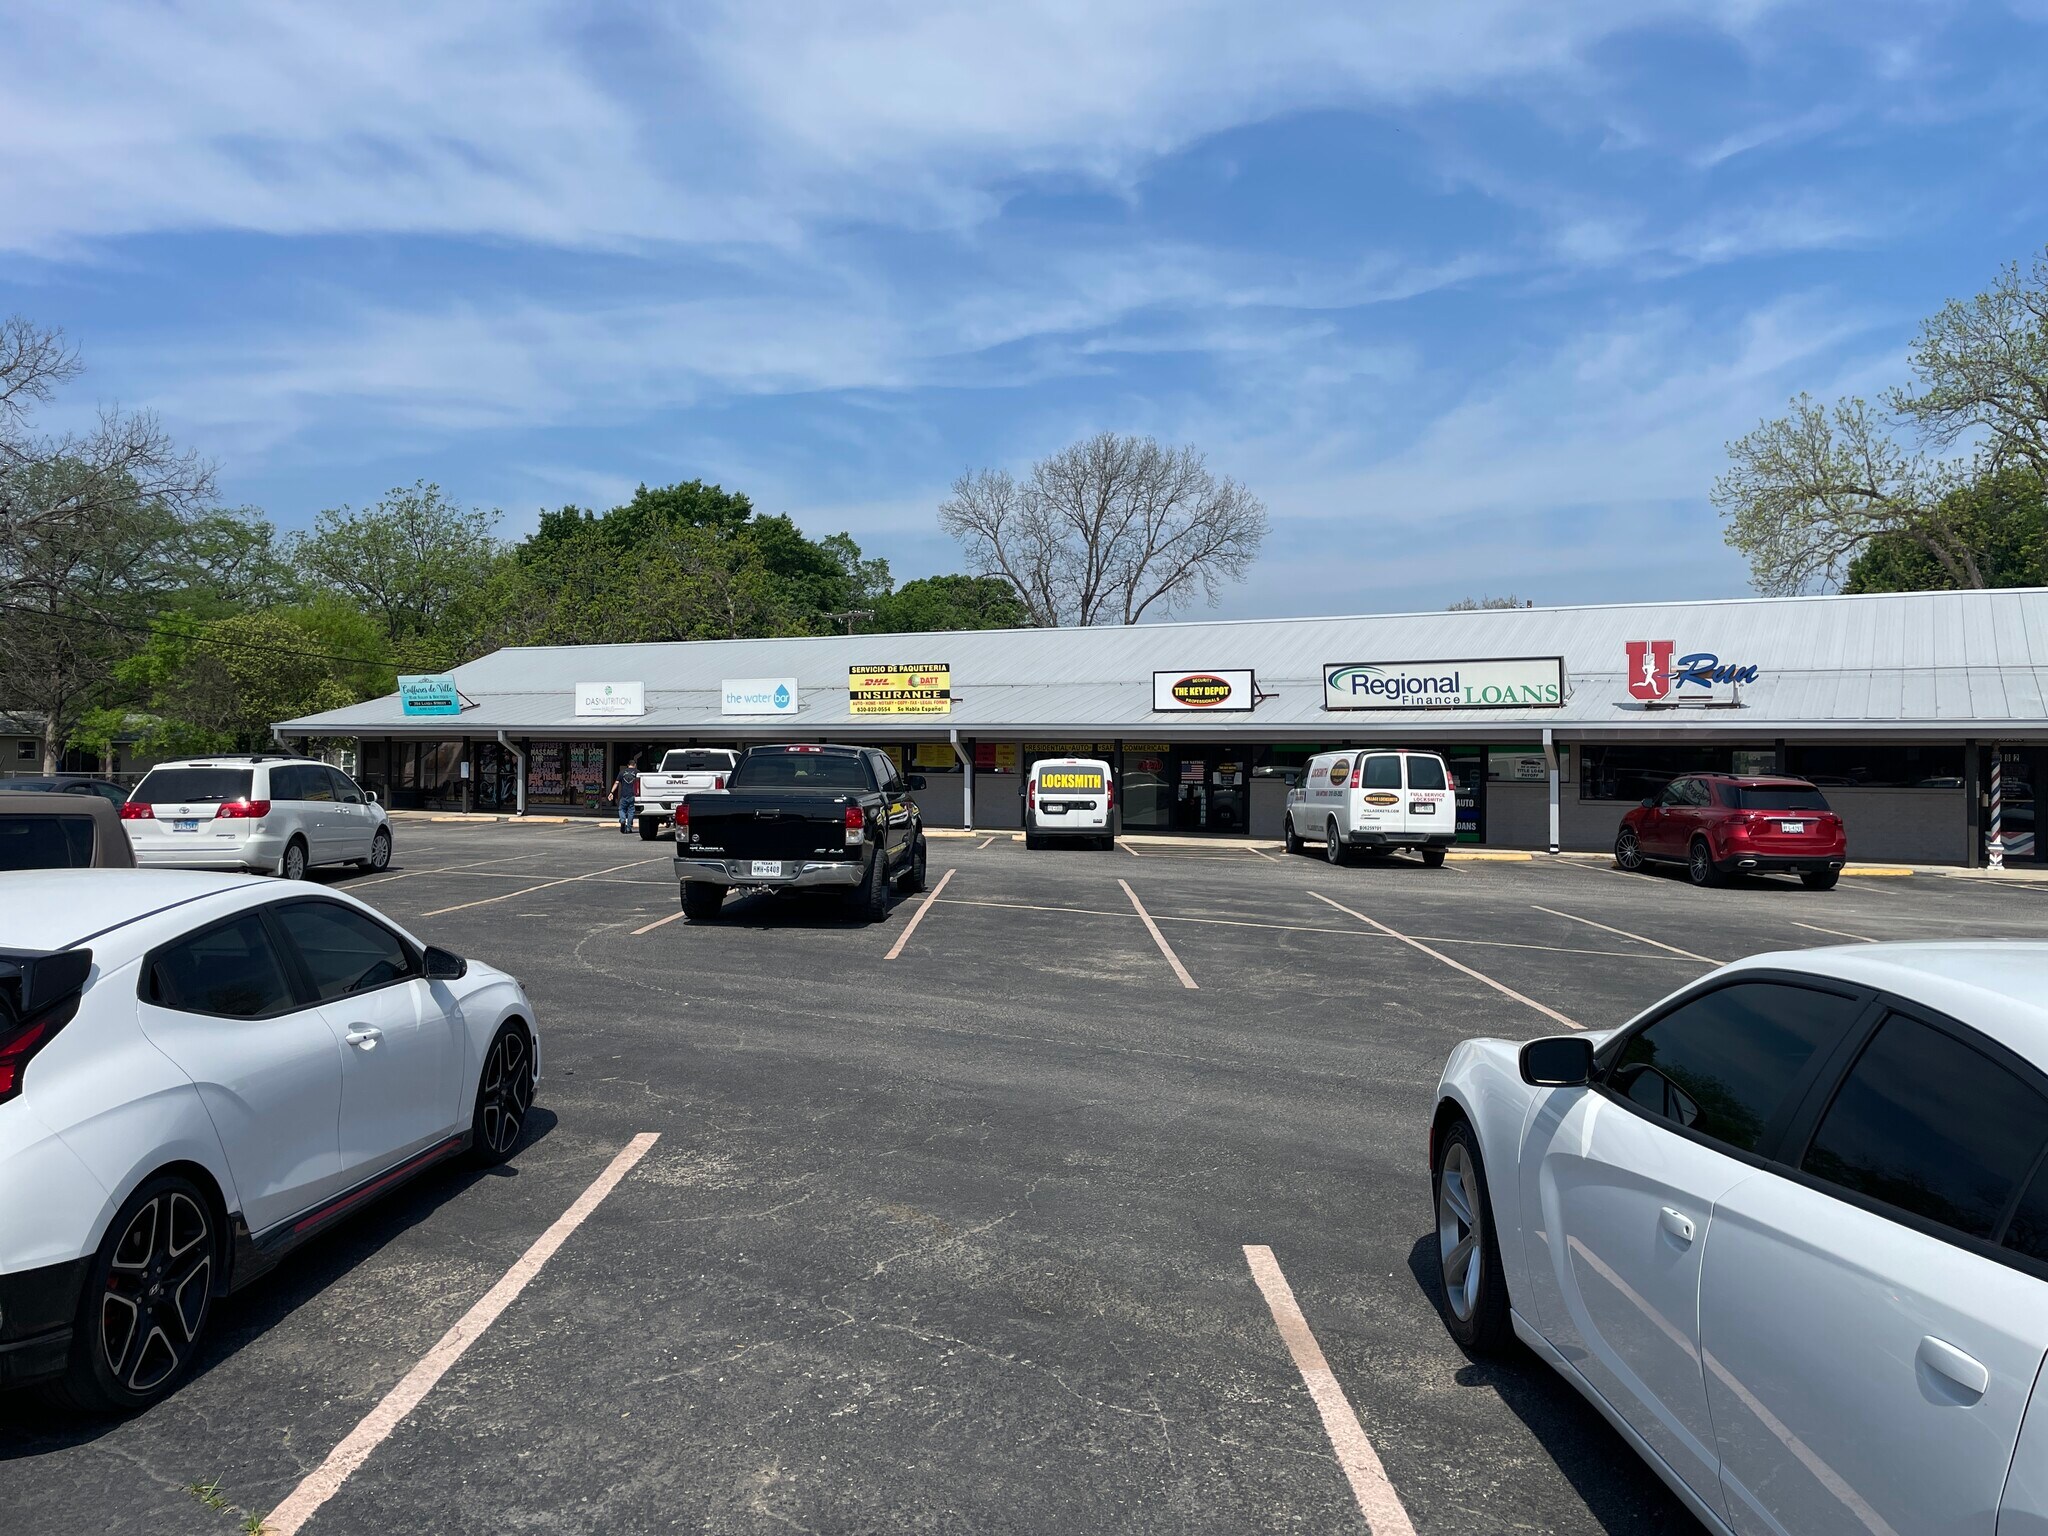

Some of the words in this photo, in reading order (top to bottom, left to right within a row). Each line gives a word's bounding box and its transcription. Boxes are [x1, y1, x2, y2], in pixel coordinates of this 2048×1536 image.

[1676, 653, 1759, 689] Run
[864, 678, 890, 686] DHL
[1352, 671, 1460, 699] Regional
[428, 684, 436, 693] de
[437, 683, 453, 692] Ville
[1174, 687, 1188, 696] THE
[1189, 687, 1203, 695] KEY
[1204, 686, 1229, 695] DEPOT
[727, 692, 742, 703] the
[744, 693, 772, 703] water
[774, 693, 789, 703] bar
[857, 690, 941, 699] INSURANCE
[1464, 684, 1559, 704] LOANS
[1403, 696, 1460, 705] Finance
[1041, 774, 1101, 788] LOCKSMITH
[1456, 799, 1474, 807] AUTO
[1456, 822, 1476, 830] OANS
